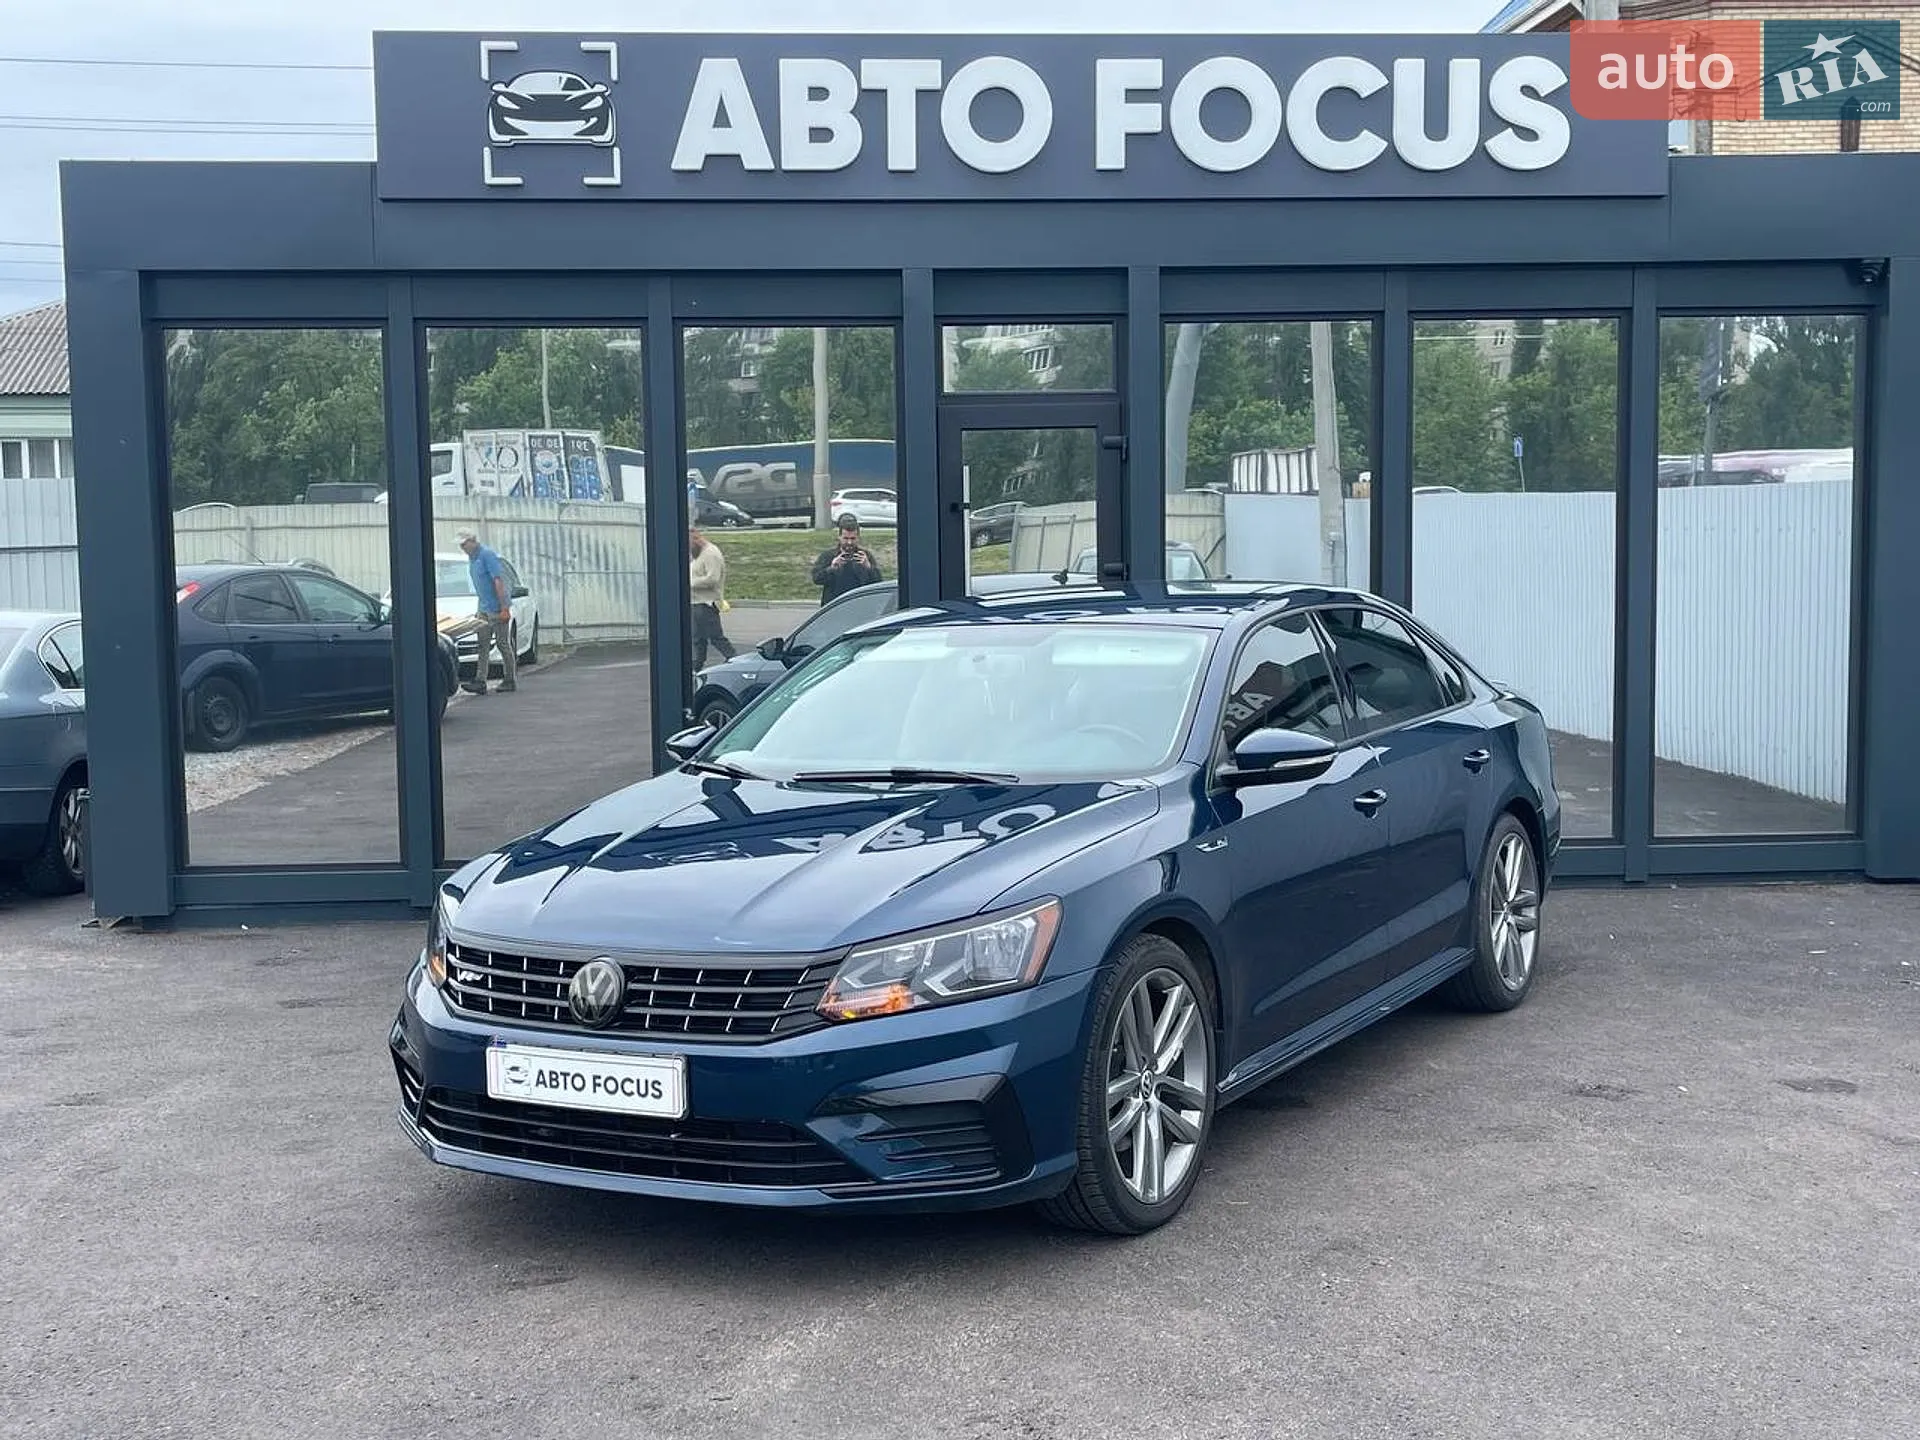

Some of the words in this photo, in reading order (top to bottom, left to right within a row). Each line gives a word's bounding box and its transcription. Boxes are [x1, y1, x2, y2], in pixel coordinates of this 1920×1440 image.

[671, 55, 1053, 174] АВТО
[1095, 55, 1571, 173] FOCUS
[535, 1069, 586, 1092] АВТО
[592, 1075, 663, 1100] FOCUS
